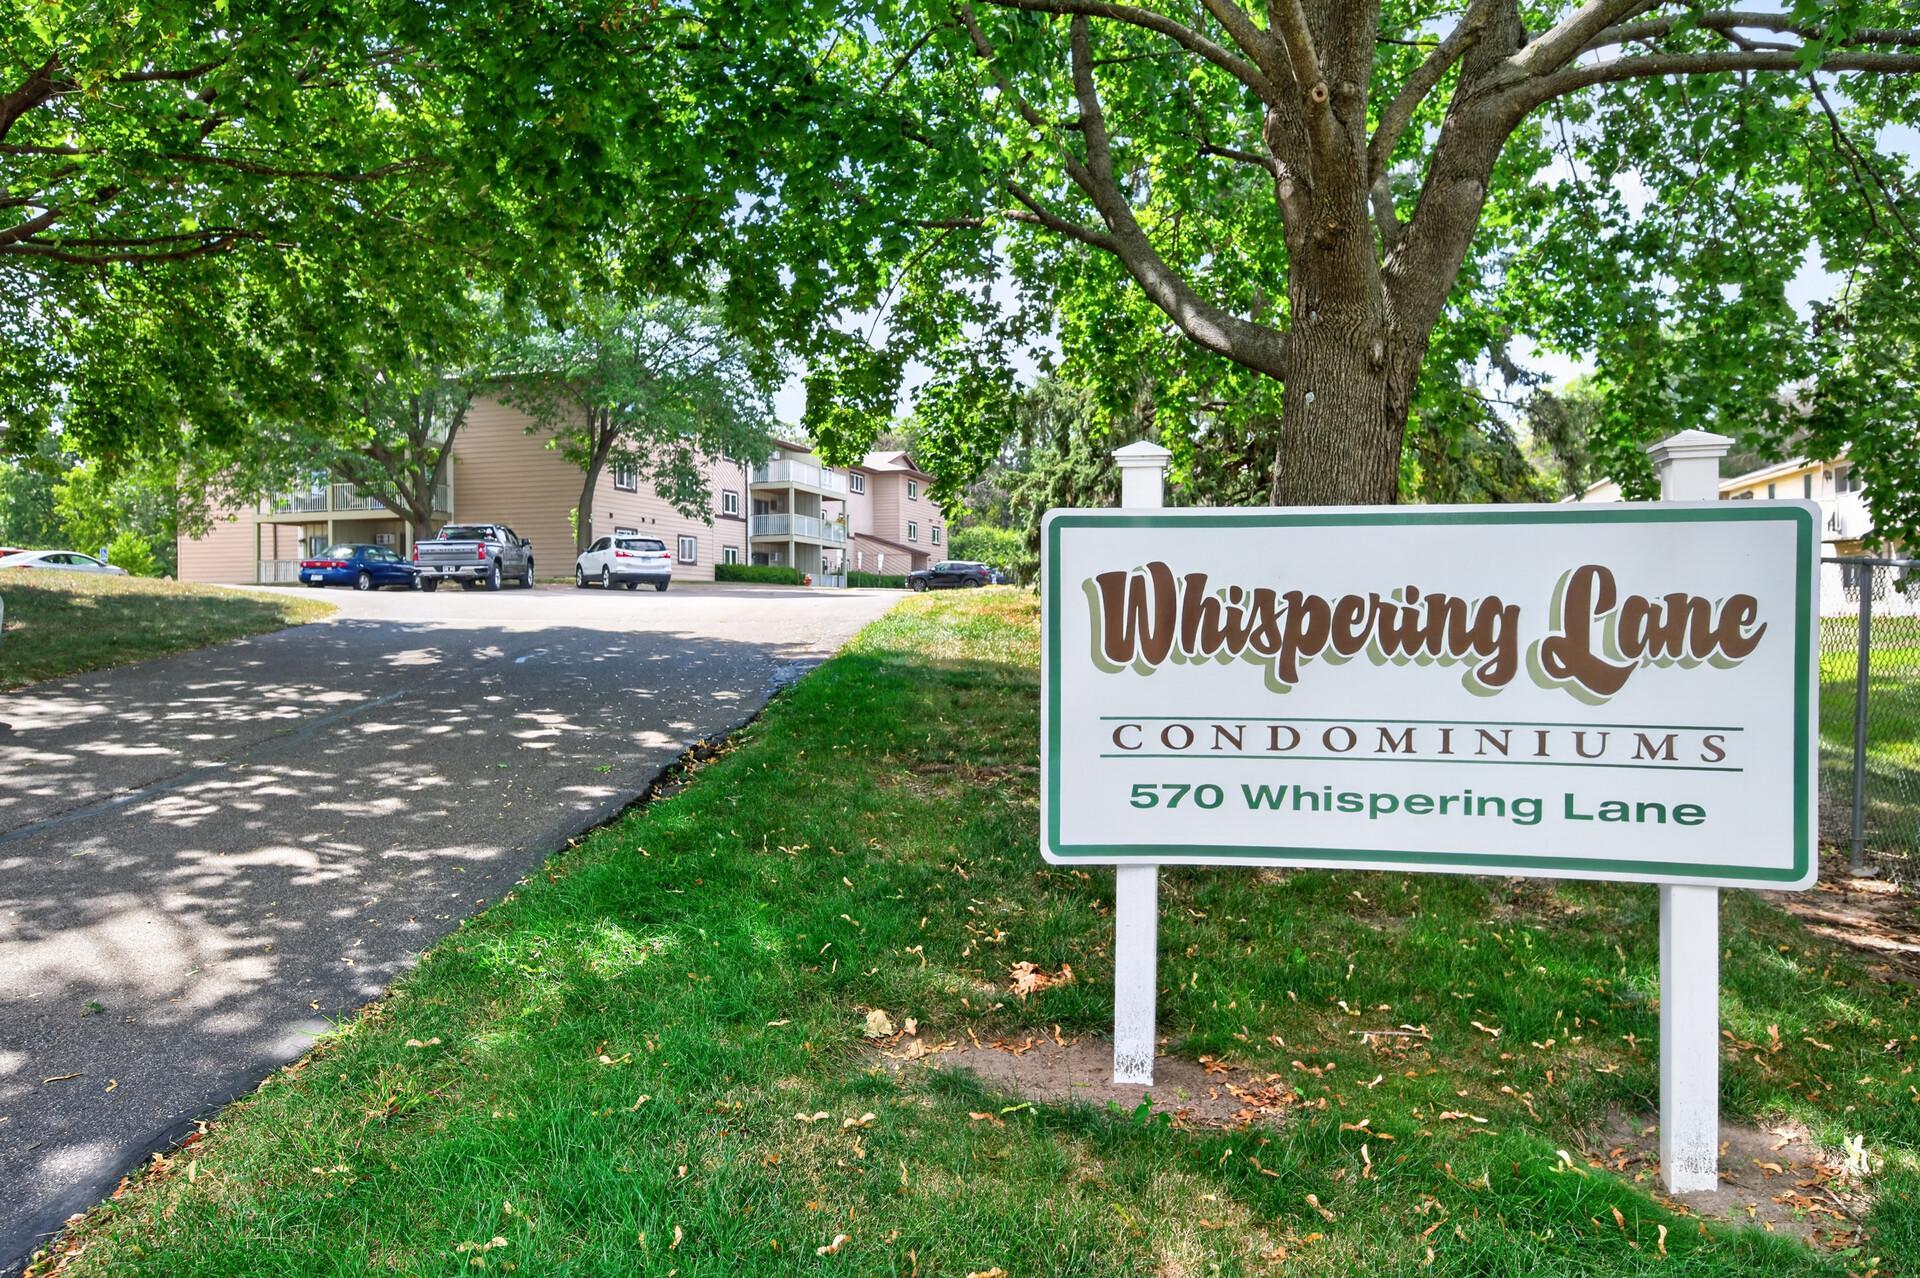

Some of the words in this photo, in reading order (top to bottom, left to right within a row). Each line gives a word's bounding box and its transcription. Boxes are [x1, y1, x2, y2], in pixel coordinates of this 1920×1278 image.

[1094, 561, 1521, 688] Whispering
[1538, 564, 1768, 697] Lane
[1111, 723, 1728, 763] CONDOMINIUMS
[1129, 783, 1225, 811] 570
[1241, 784, 1543, 826] Whispering
[1564, 792, 1708, 826] Lane
